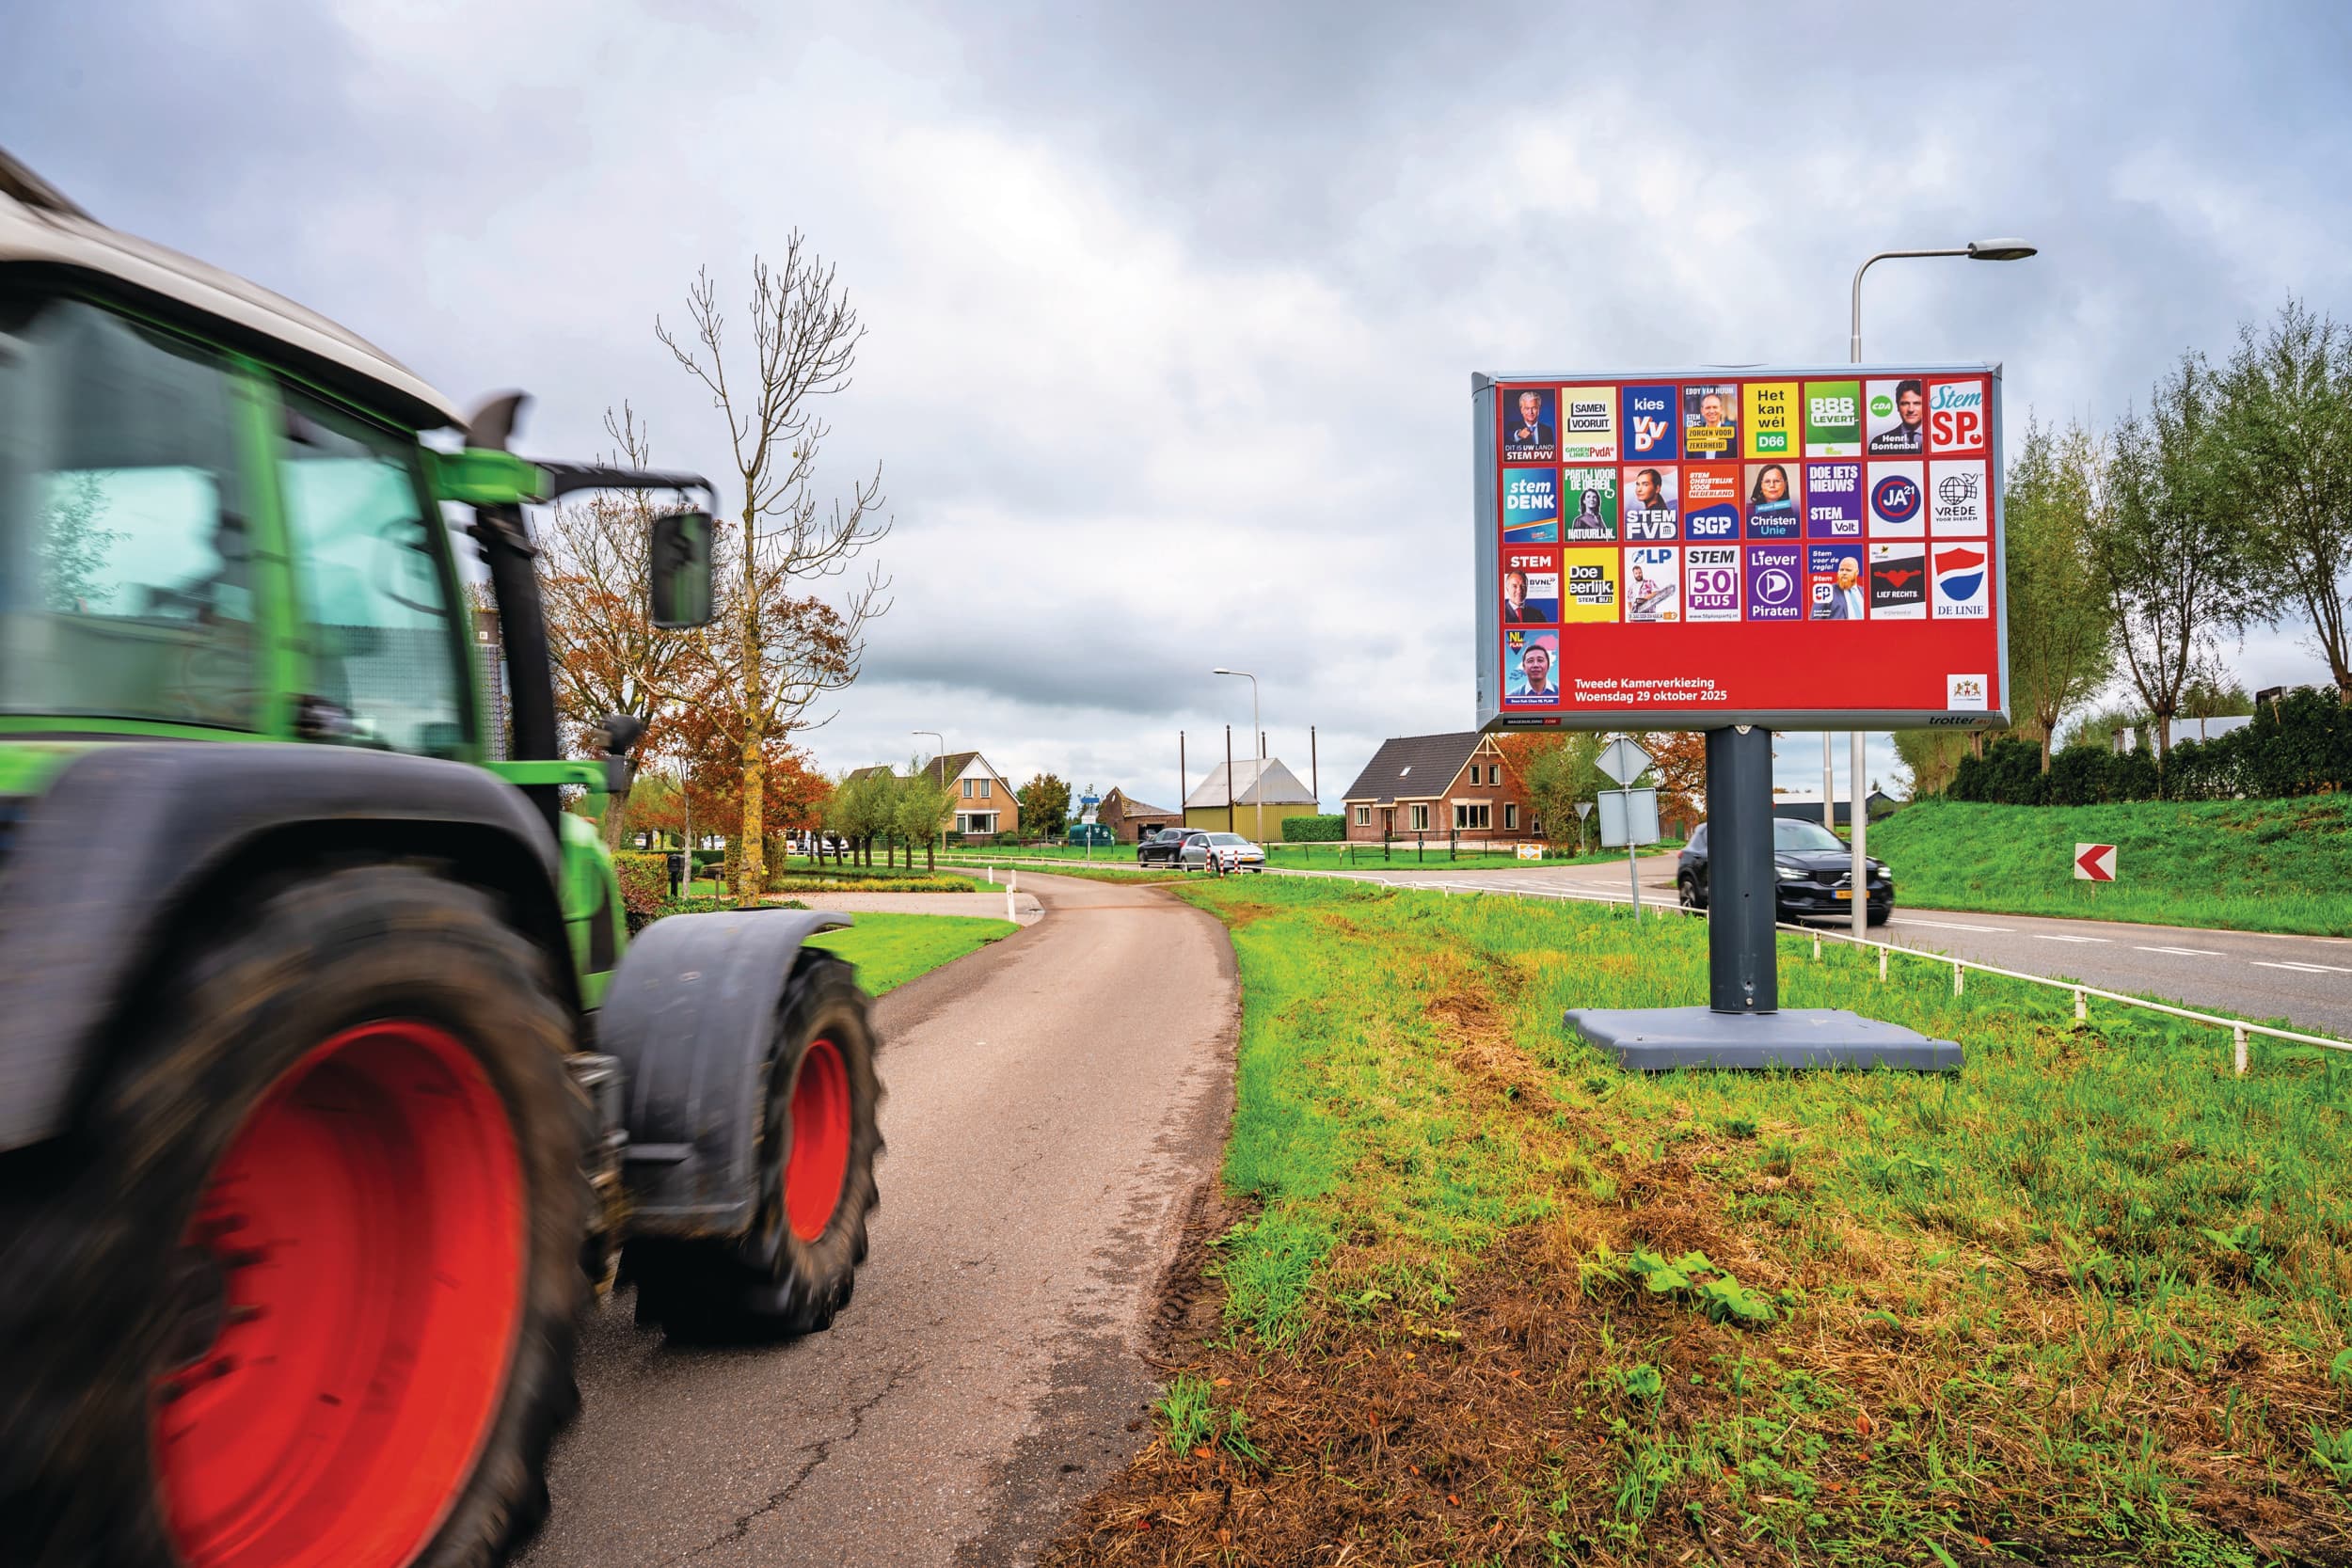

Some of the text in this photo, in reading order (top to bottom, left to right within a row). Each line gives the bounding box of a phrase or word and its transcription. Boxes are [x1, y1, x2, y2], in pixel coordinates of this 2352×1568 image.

[1758, 390, 1784, 401] Het
[1930, 385, 1982, 410] Stem
[1575, 404, 1605, 413] SAMEN
[1635, 397, 1664, 411] kies
[1758, 404, 1784, 414] kan
[1810, 397, 1855, 414] BBB
[1872, 402, 1891, 411] CDA
[1572, 419, 1609, 428] VOORUIT
[1758, 416, 1785, 428] wél
[1759, 436, 1785, 448] D66
[1871, 442, 1919, 450] Bontenbal
[1507, 451, 1553, 460] STEM PVV
[1565, 468, 1616, 481] PARTIJ VOOR
[1810, 465, 1858, 479] DOE IETS
[1510, 478, 1551, 494] stem
[1570, 479, 1581, 491] DE
[1810, 479, 1855, 492] NIEUWS
[1507, 494, 1555, 510] DENK
[1626, 509, 1677, 523] STEM
[1811, 507, 1843, 520] STEM
[1935, 506, 1976, 516] VREDE
[1693, 516, 1732, 535] SGP
[1750, 515, 1796, 526] Christen
[1626, 522, 1677, 540] FVD
[1761, 526, 1786, 535] Unie
[1835, 522, 1856, 532] Volt
[1510, 555, 1551, 568] STEM
[1646, 549, 1672, 564] LP
[1689, 550, 1735, 564] STEM
[1752, 551, 1797, 566] Liever
[1570, 566, 1598, 578] Doe
[1694, 570, 1731, 594] 50
[1694, 595, 1731, 606] PLUS
[1752, 605, 1798, 617] Piraten
[1938, 605, 1984, 615] DE LINIE
[1509, 631, 1523, 642] NL
[1574, 677, 1715, 689] Tweede Kamerverkiezing
[1574, 690, 1727, 704] Woensdag 29 oktober 2025
